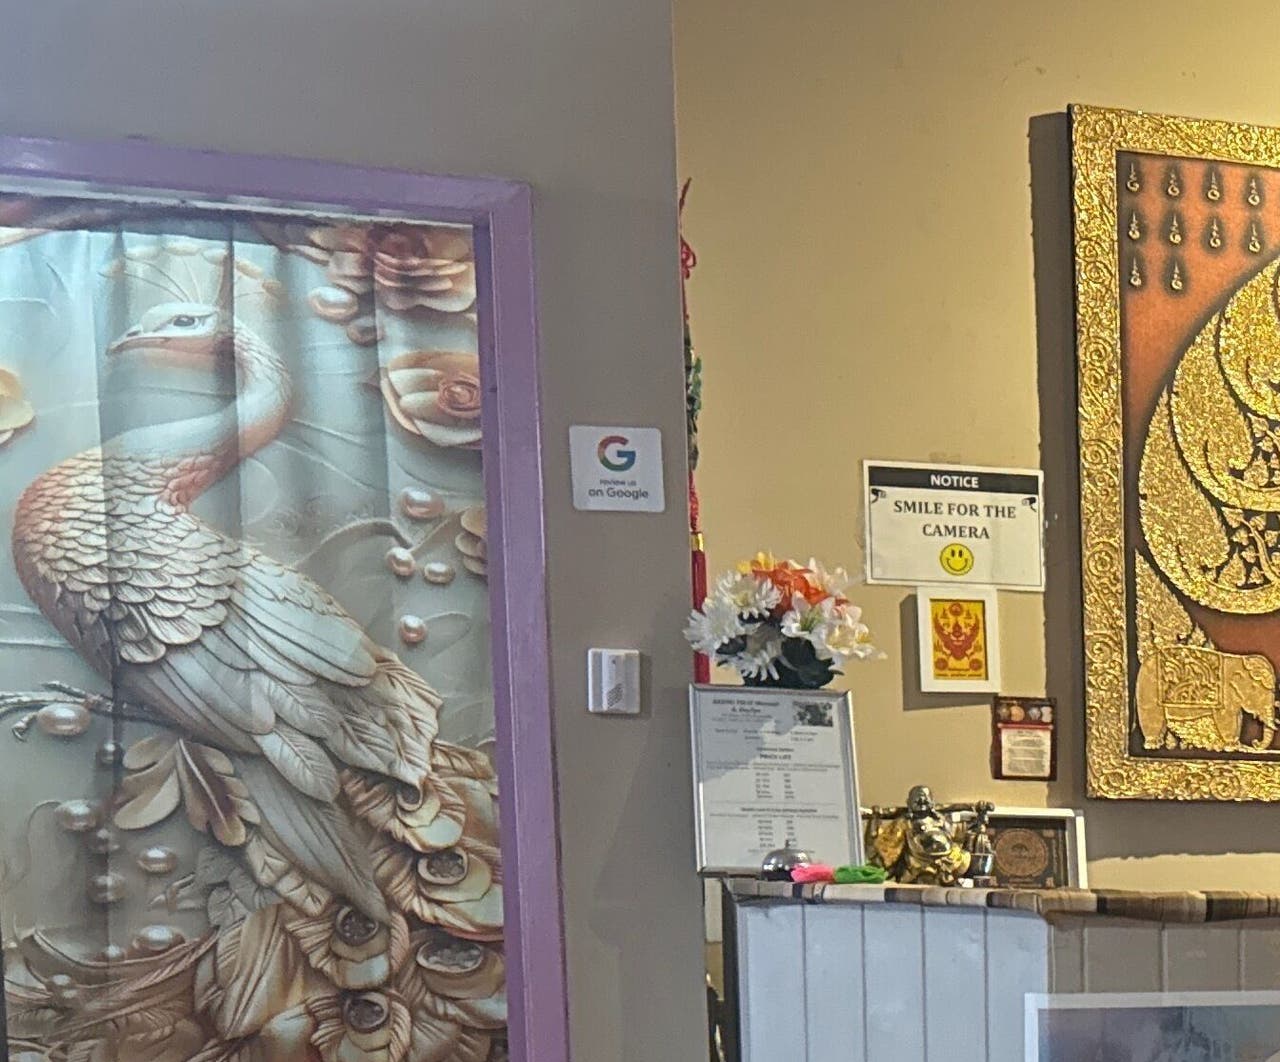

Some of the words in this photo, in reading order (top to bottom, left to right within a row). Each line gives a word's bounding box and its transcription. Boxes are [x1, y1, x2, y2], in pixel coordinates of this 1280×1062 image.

[597, 435, 636, 472] G
[930, 474, 980, 489] NOTICE
[588, 488, 605, 498] on
[606, 487, 649, 500] Google
[893, 500, 944, 515] SMILE
[947, 503, 980, 517] FOR
[983, 505, 1017, 519] THE
[922, 523, 990, 540] CAMERA
